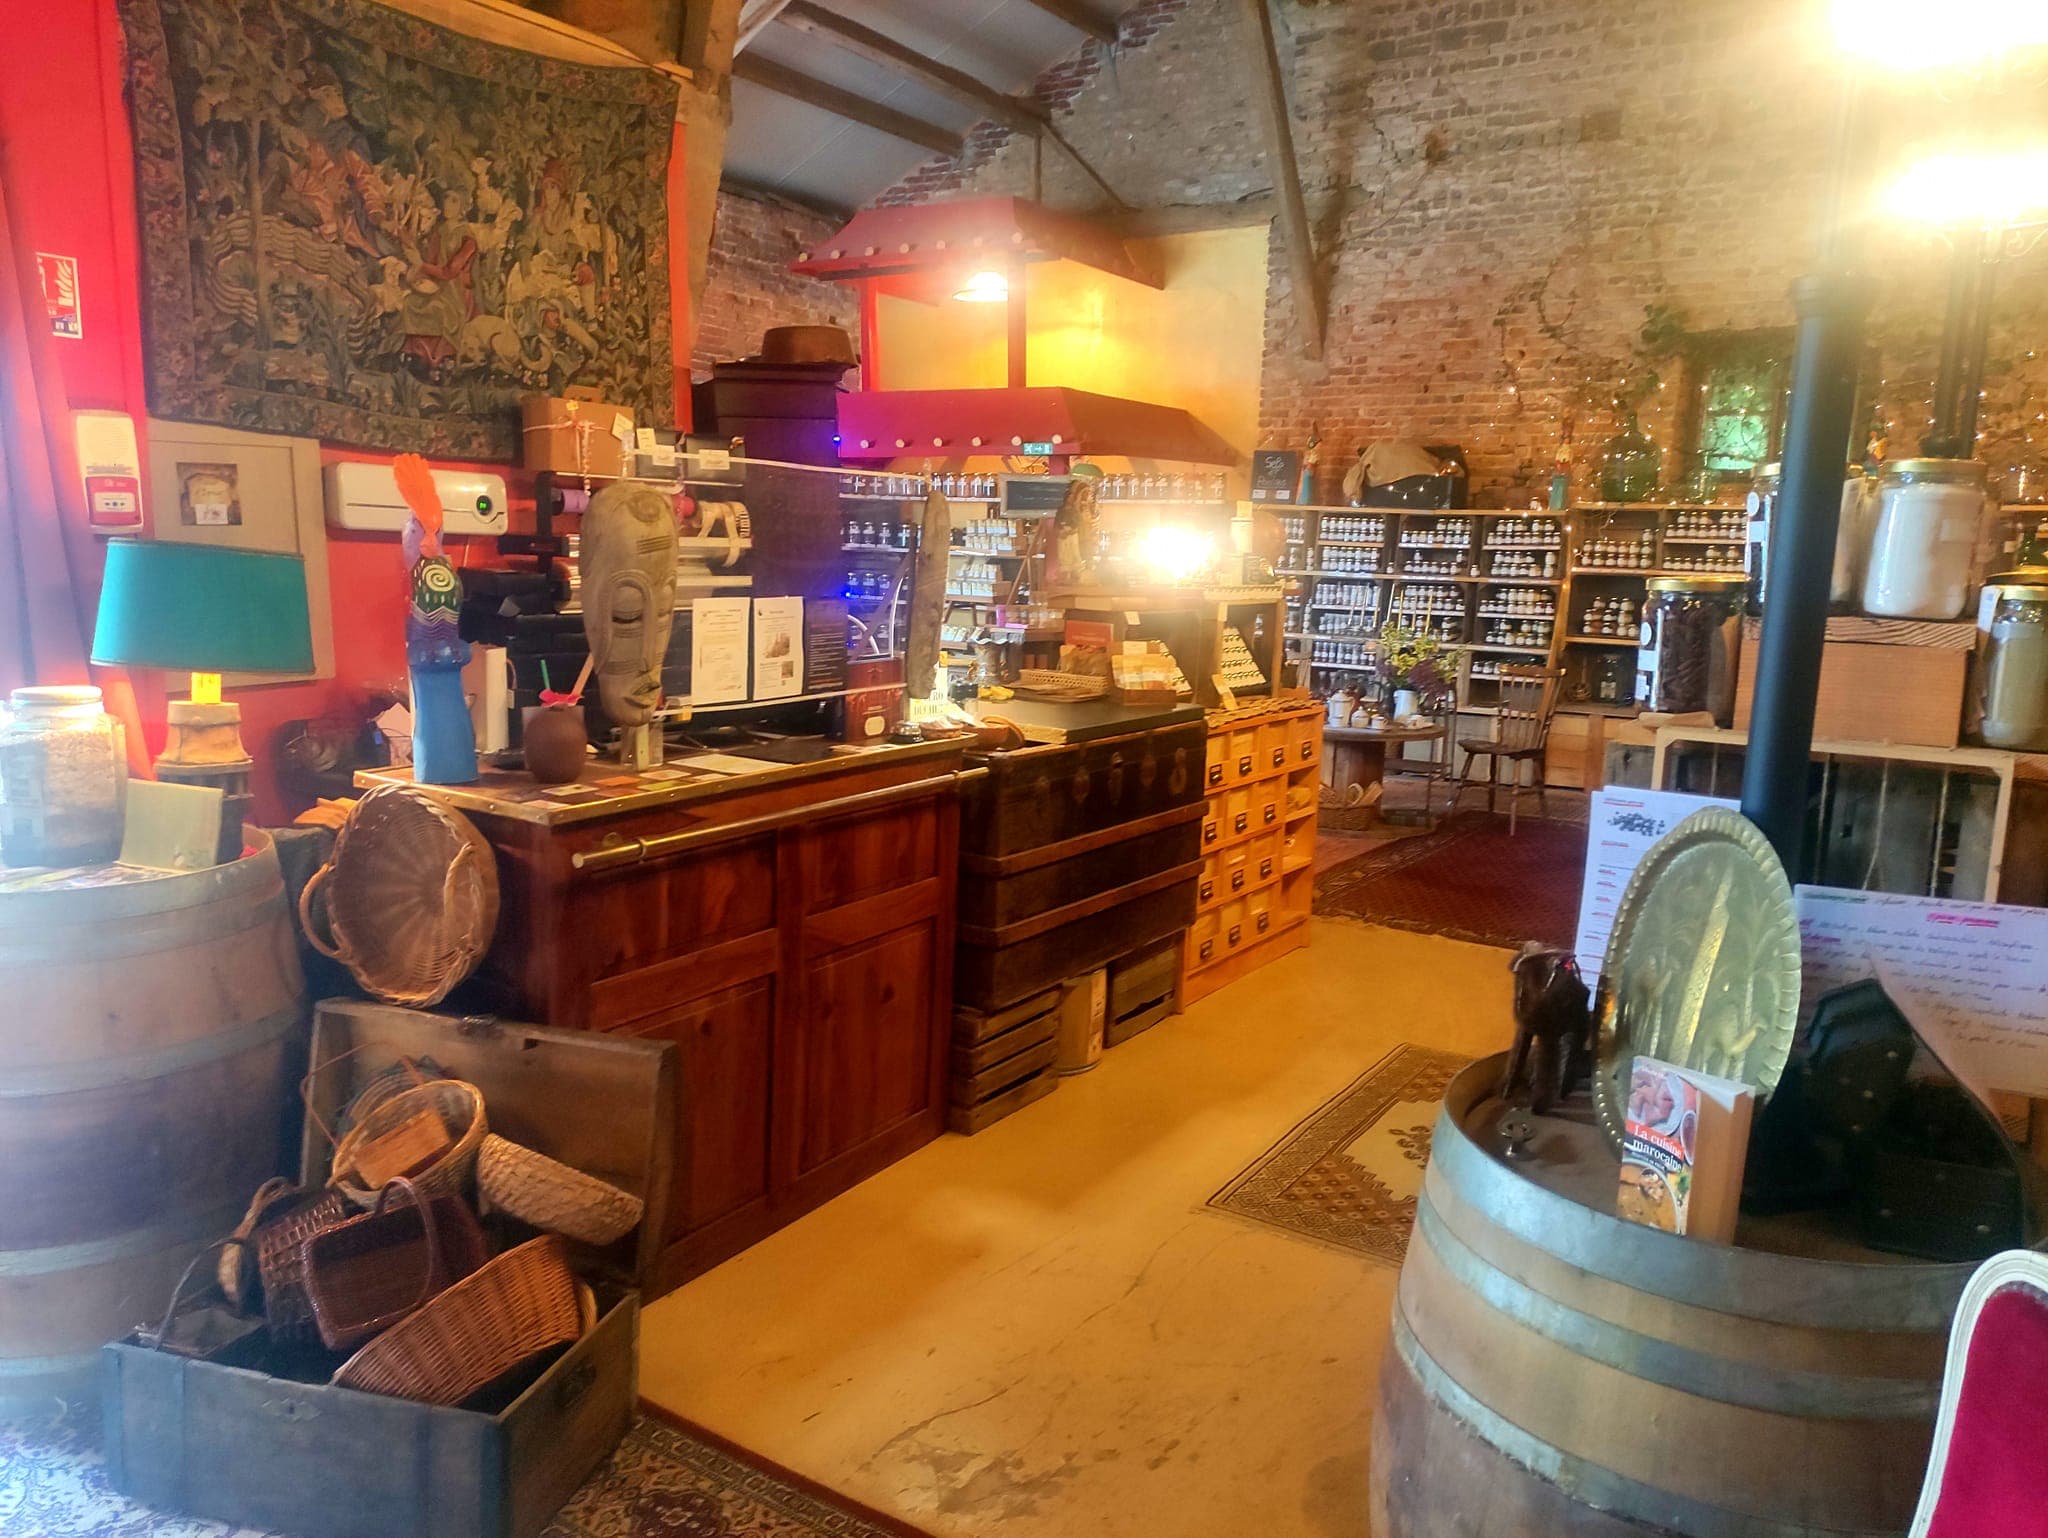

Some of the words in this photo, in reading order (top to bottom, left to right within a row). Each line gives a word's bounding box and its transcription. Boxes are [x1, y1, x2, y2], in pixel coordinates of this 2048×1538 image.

[1632, 1139, 1682, 1173] marocaine
[1634, 1125, 1648, 1140] La
[1650, 1133, 1683, 1159] cuisine
